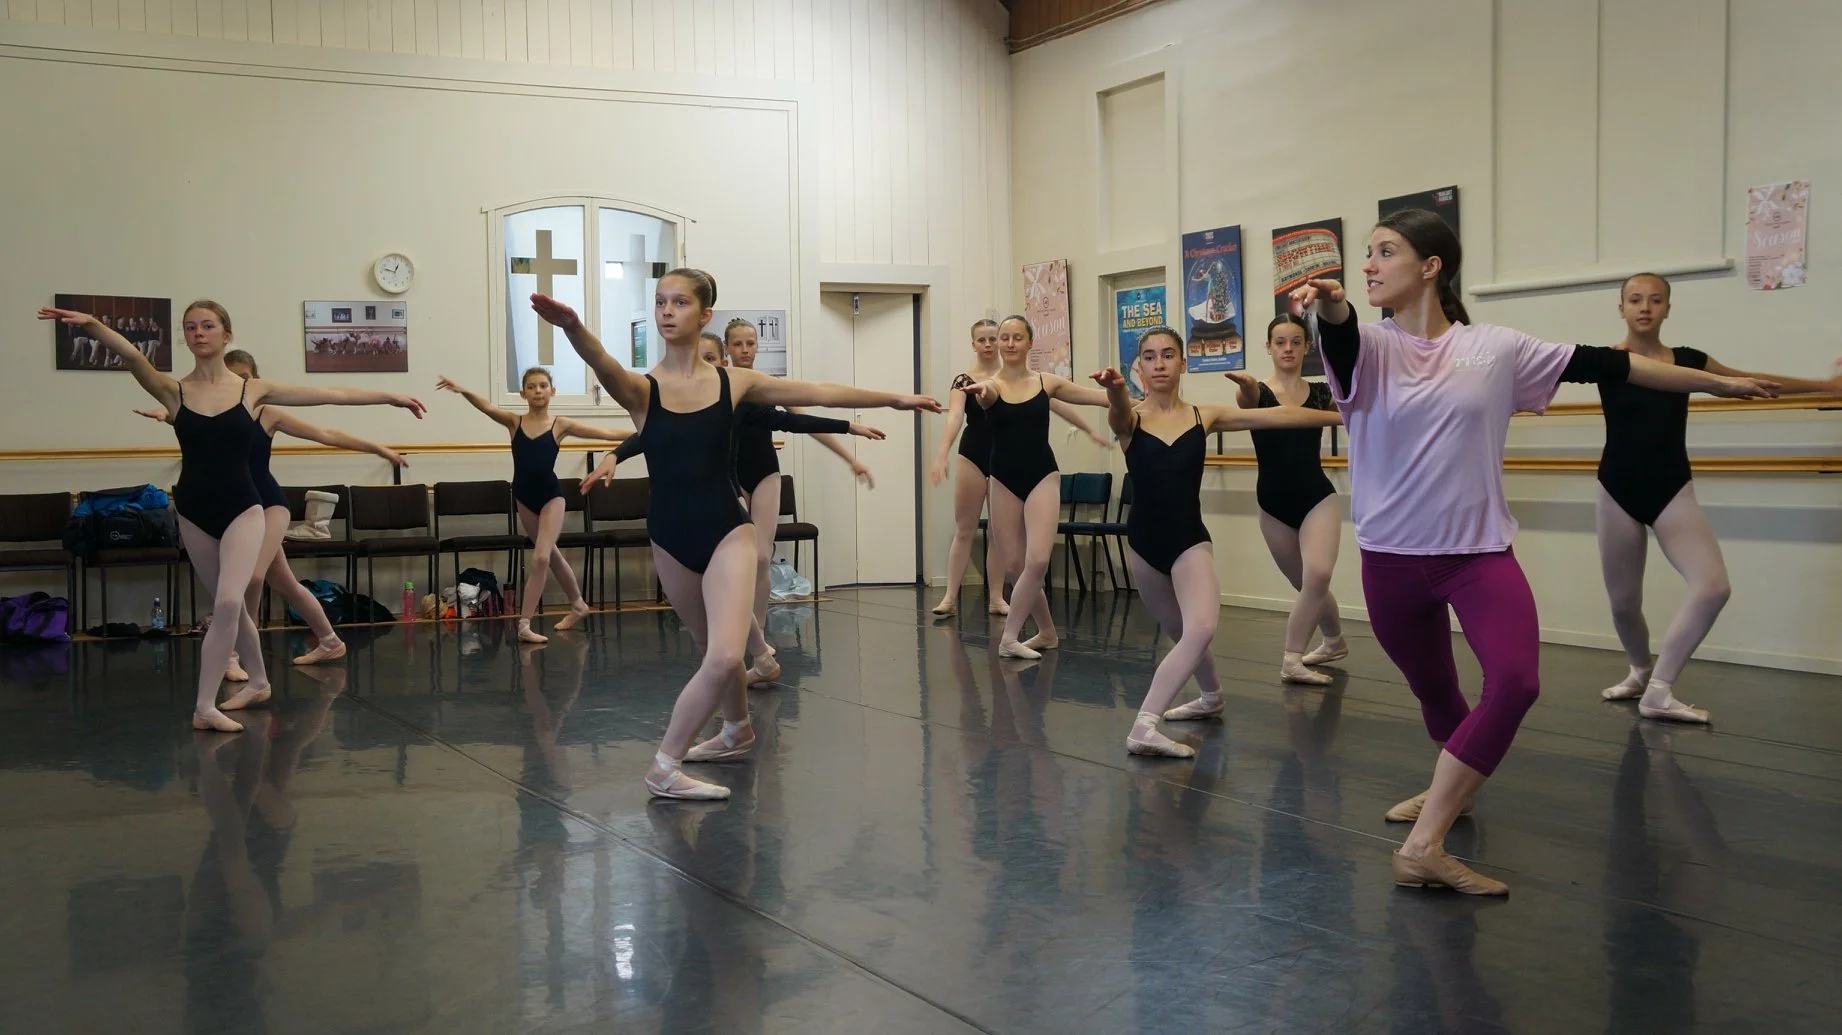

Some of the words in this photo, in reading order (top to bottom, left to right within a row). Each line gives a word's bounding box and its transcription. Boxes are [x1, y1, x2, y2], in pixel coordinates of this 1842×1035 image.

[1753, 227, 1801, 249] Season
[1121, 304, 1141, 319] THE
[1142, 301, 1163, 317] SEA
[1122, 319, 1136, 329] AND
[1137, 316, 1163, 328] BEYOND
